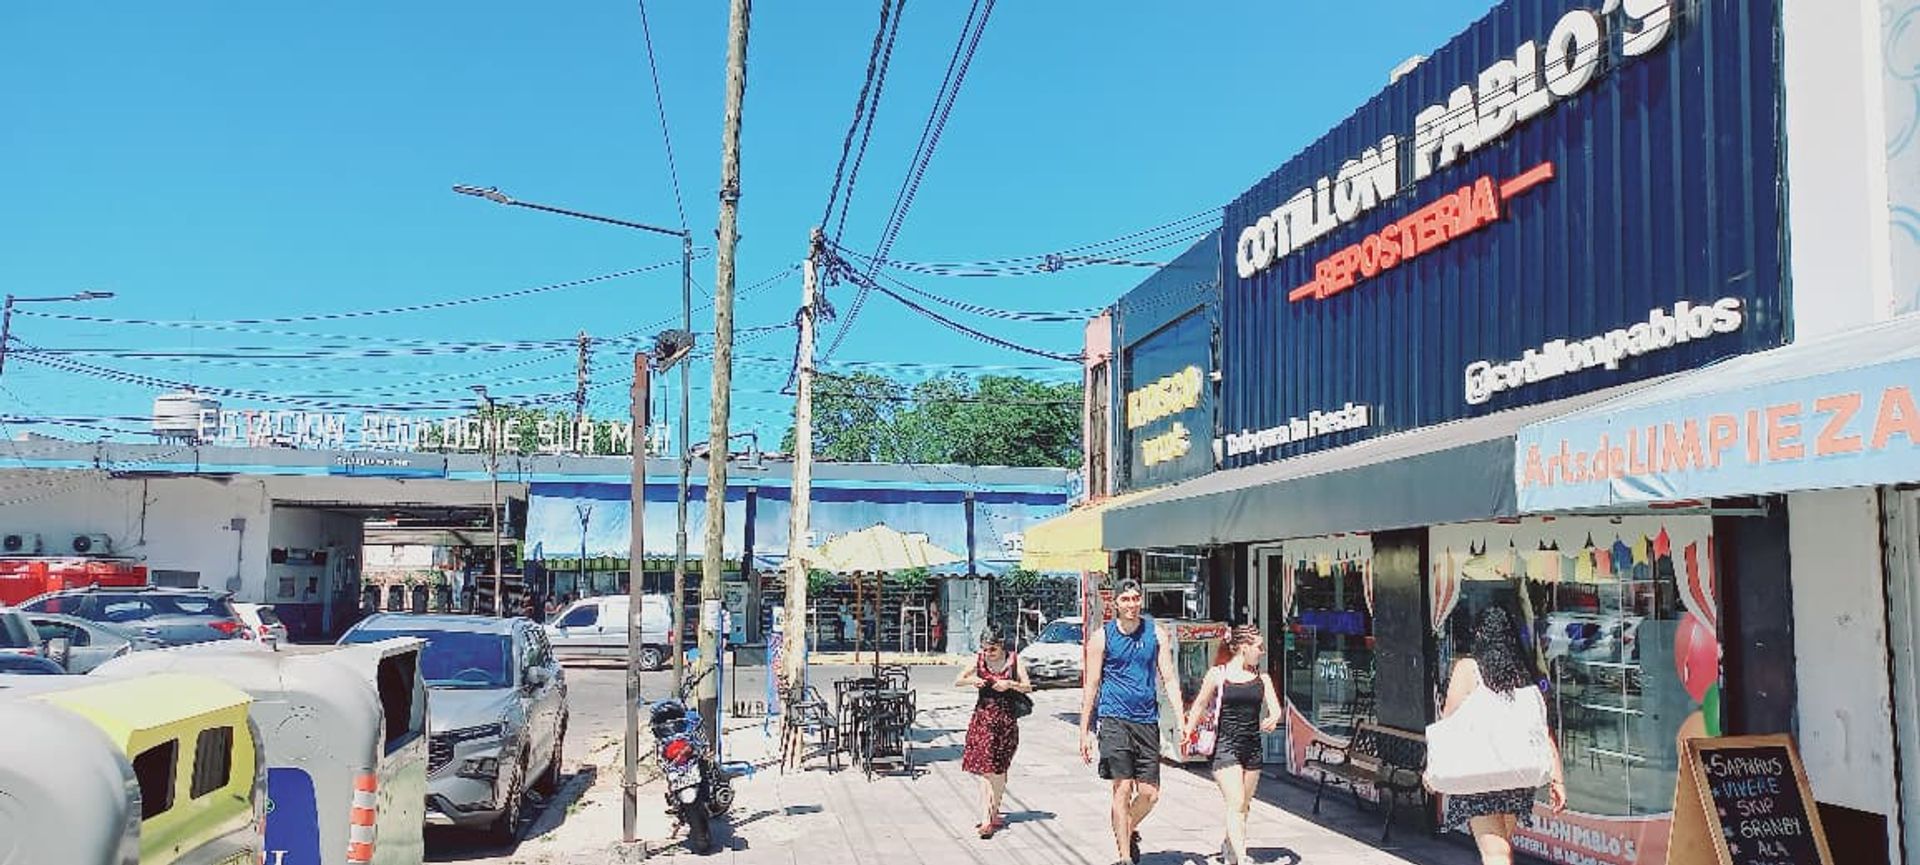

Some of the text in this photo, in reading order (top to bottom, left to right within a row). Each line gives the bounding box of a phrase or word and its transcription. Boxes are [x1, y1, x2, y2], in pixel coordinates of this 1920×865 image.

[1237, 134, 1397, 279] COTILLON
[1314, 175, 1499, 300] REPOSTERIA
[1465, 297, 1743, 404] @cotillonpablos
[199, 408, 670, 453] ESTACION BOULOGNE SUR MR
[1626, 385, 1920, 477] LIMPIEZA
